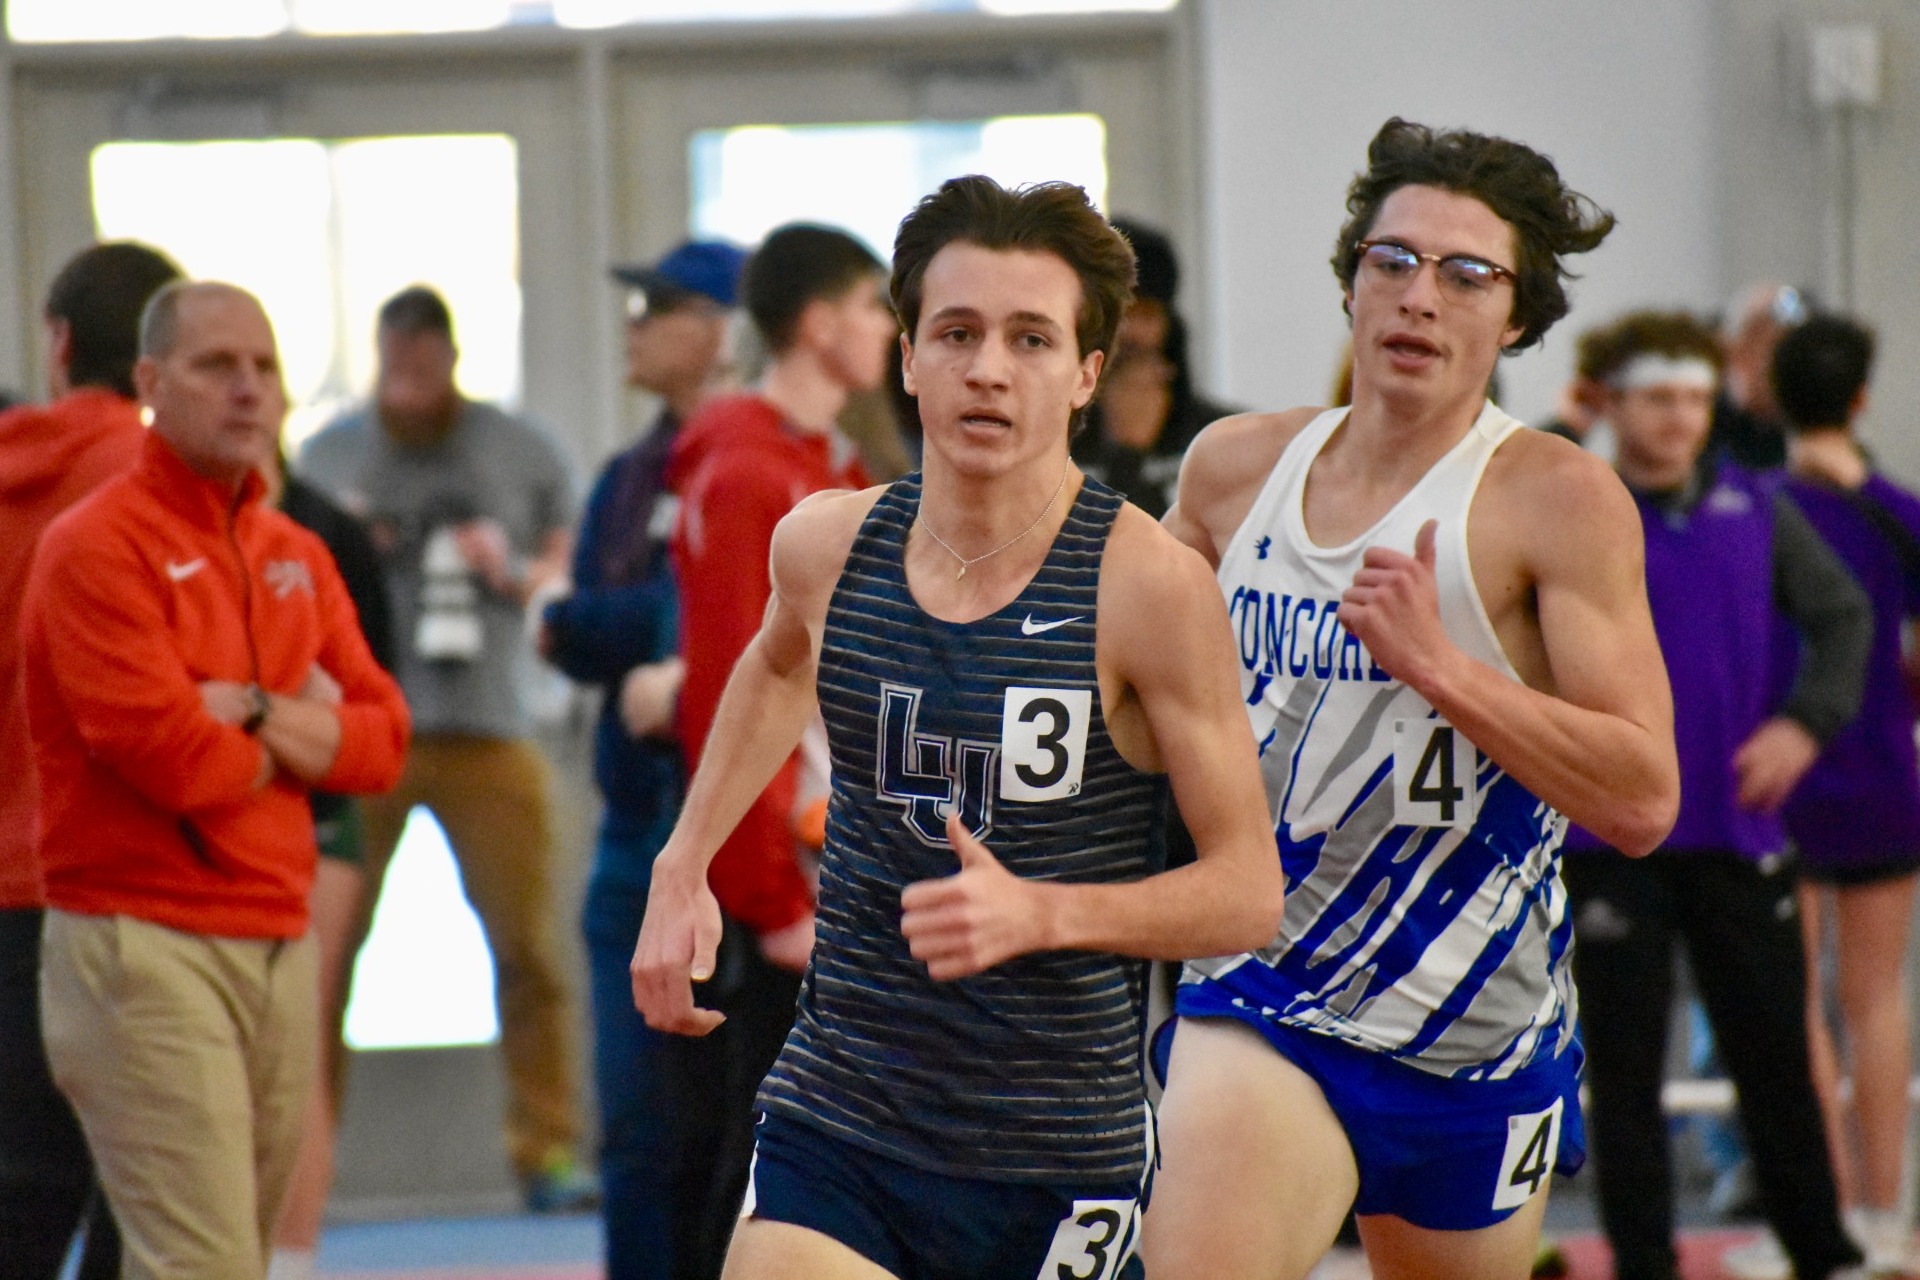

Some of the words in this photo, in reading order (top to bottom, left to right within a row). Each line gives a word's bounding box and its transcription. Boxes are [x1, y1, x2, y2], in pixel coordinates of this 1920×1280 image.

[1230, 585, 1393, 682] ONCOR
[1014, 697, 1071, 788] 3
[1408, 726, 1464, 822] 4
[1509, 1112, 1552, 1196] 4
[1057, 1207, 1121, 1280] 3
